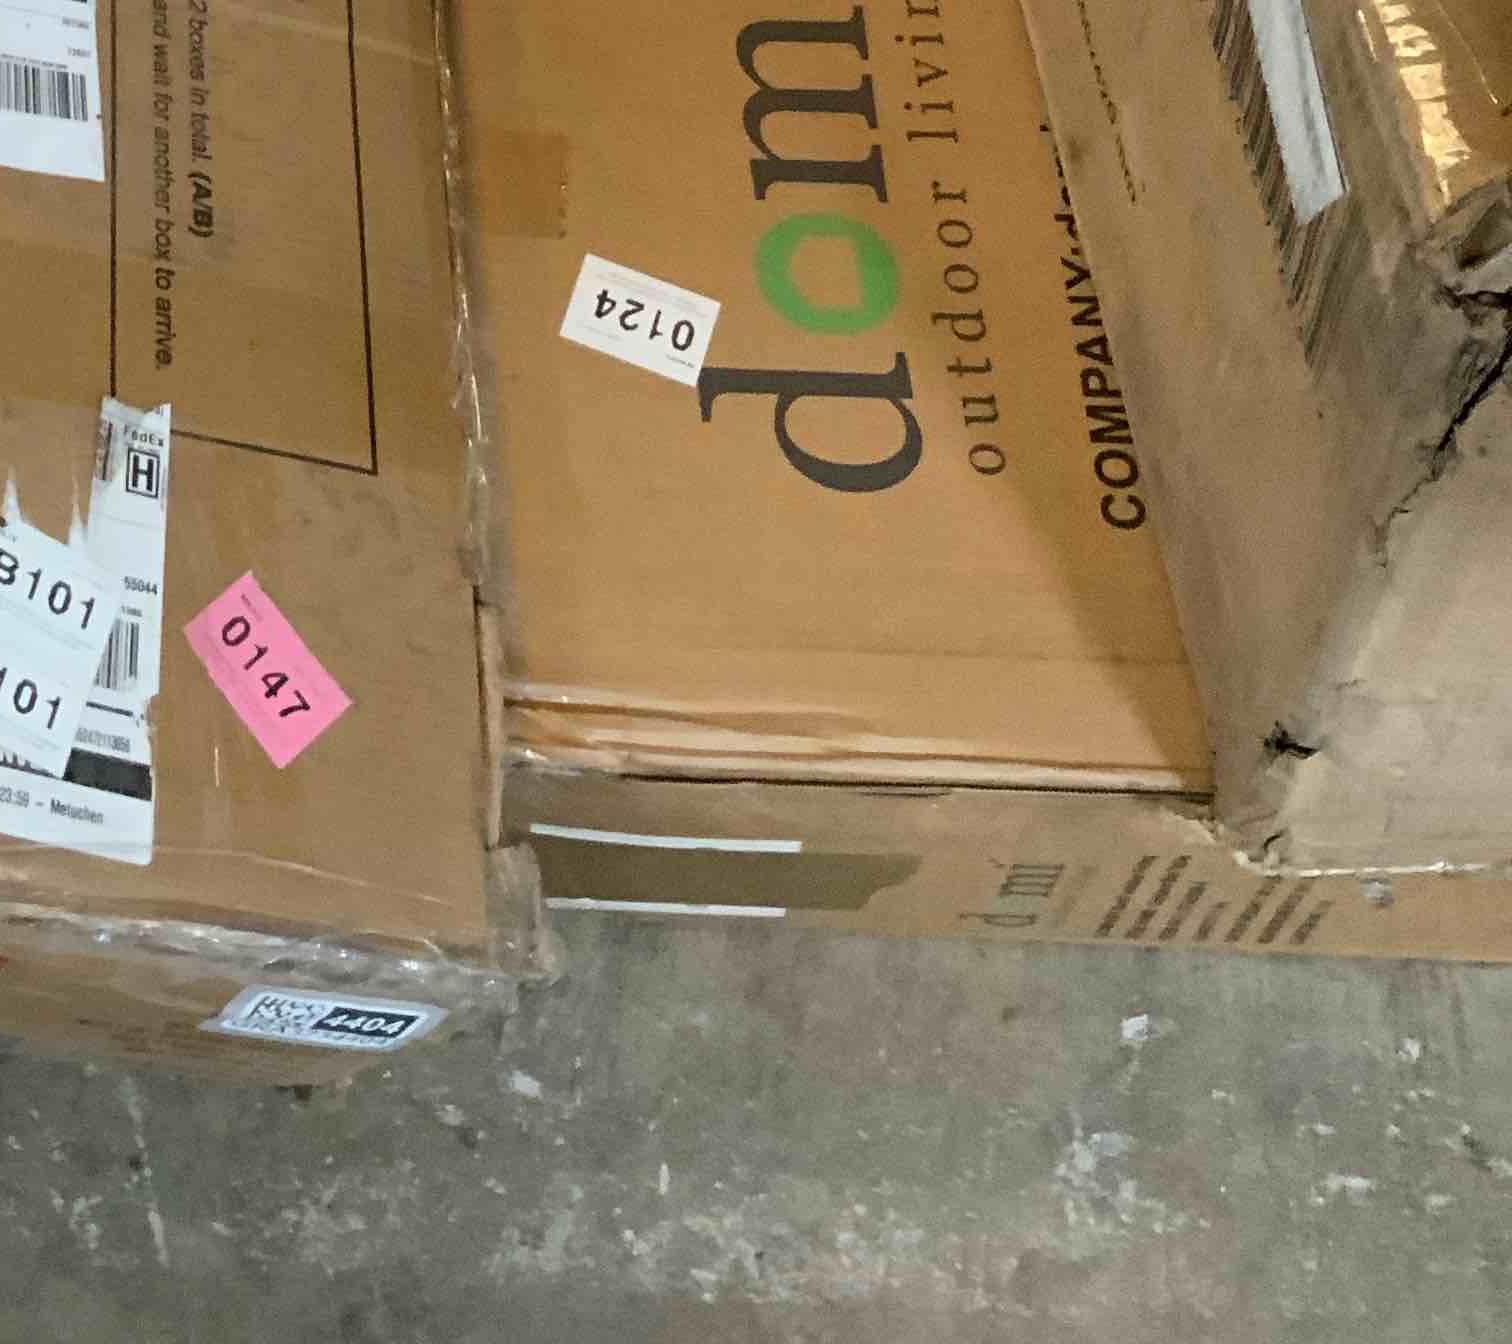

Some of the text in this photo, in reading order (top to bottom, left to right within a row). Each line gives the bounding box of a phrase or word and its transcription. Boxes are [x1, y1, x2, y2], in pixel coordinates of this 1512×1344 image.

[153, 43, 173, 86] wait
[189, 17, 209, 80] boxes
[153, 91, 174, 121] for
[191, 86, 211, 106] in
[191, 111, 213, 162] total.
[153, 126, 176, 213] another
[187, 171, 215, 238] (A/B)
[152, 217, 176, 261] box
[155, 266, 177, 290] to
[154, 296, 177, 371] arrive.
[593, 287, 698, 354] 0124
[932, 179, 1007, 476] outdoor
[131, 455, 156, 493] H
[221, 615, 311, 718] 0147
